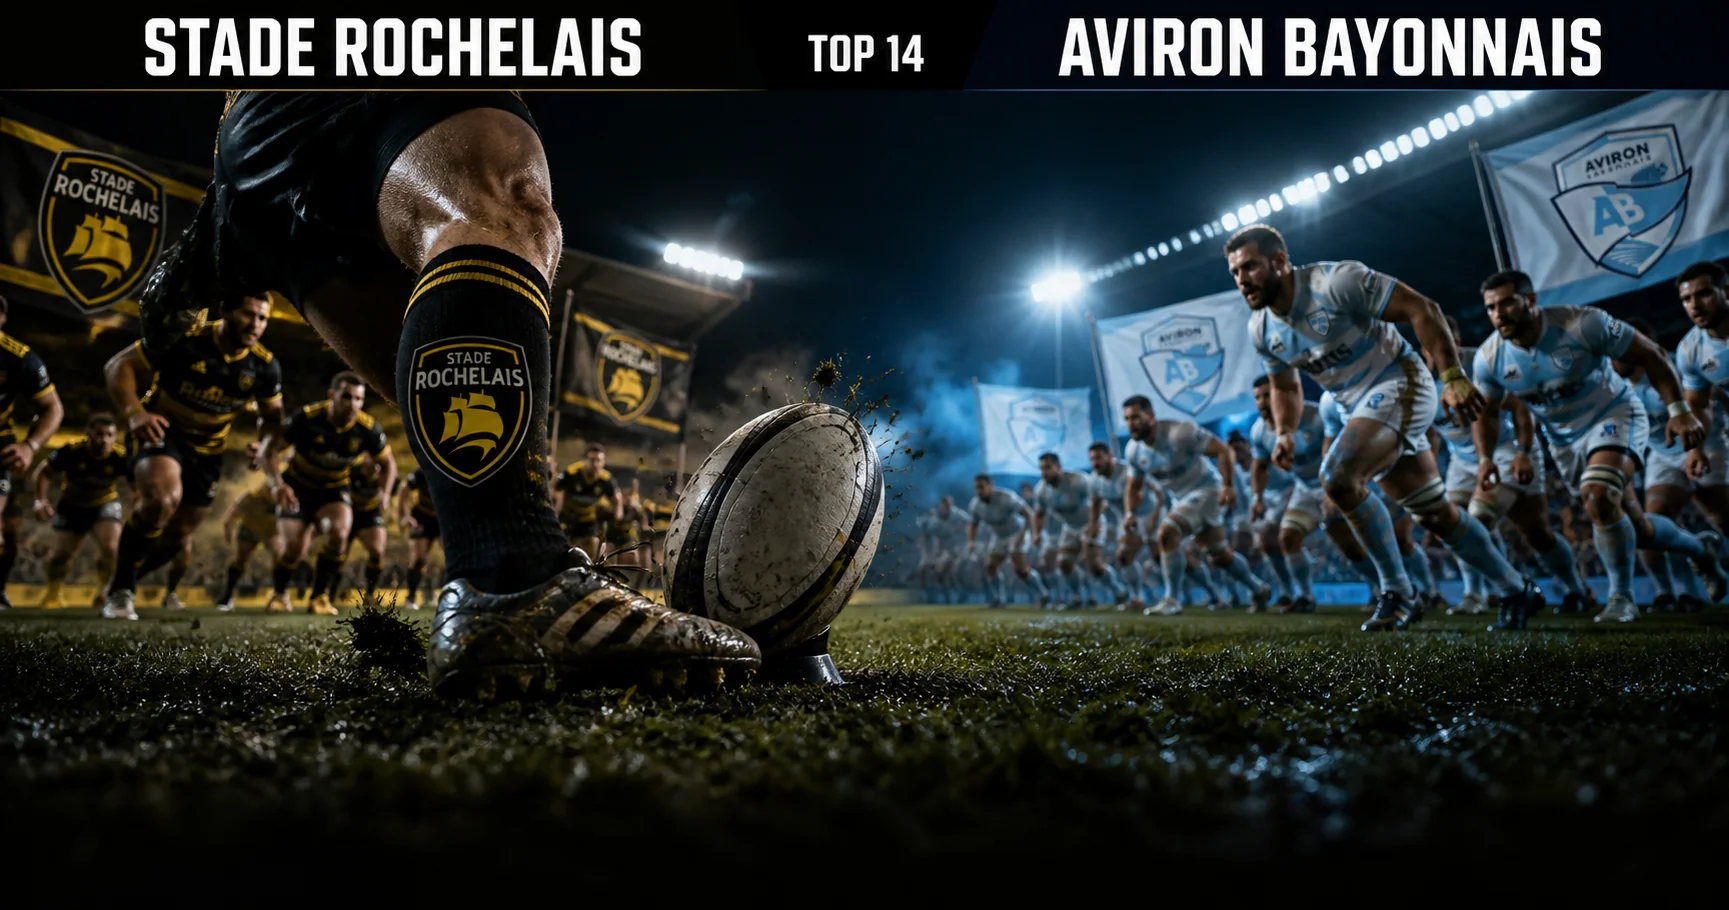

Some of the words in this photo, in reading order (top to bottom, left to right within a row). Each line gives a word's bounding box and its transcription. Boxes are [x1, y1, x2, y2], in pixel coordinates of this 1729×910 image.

[1585, 142, 1650, 172] AVIRON
[90, 168, 136, 195] STADE
[54, 174, 160, 224] ROCHELAIS
[1592, 193, 1645, 237] AB
[447, 352, 492, 365] STADE
[1164, 358, 1199, 385] AB
[415, 367, 525, 390] ROCHELAIS
